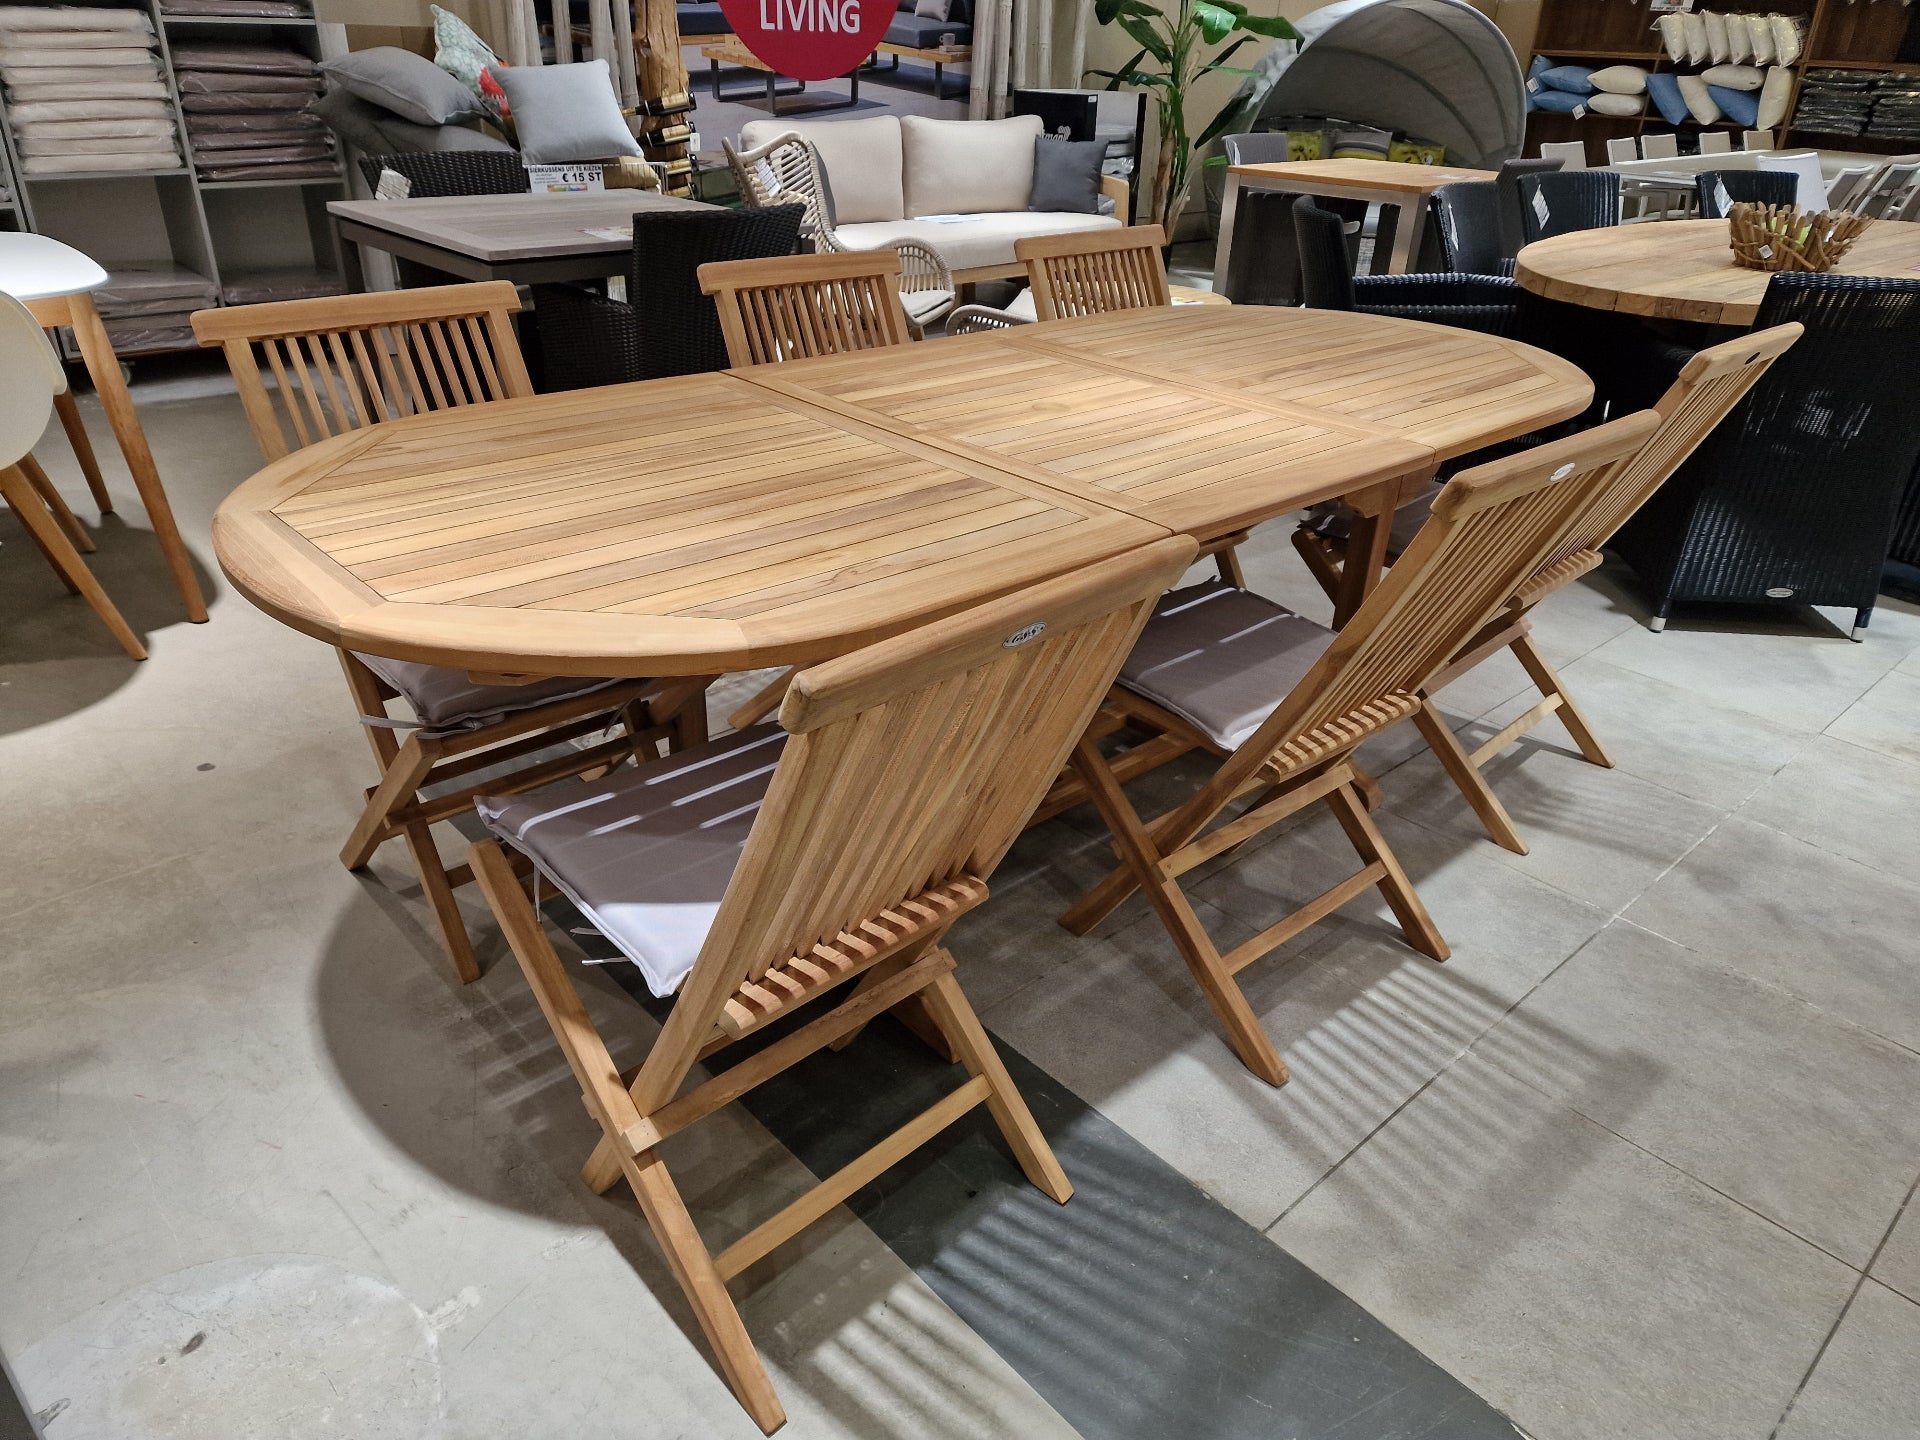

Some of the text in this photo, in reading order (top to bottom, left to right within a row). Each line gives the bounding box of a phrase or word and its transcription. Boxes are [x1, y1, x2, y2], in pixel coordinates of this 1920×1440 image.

[760, 0, 860, 34] LIVING
[562, 173, 569, 182] €
[572, 172, 585, 182] 15
[588, 172, 602, 182] ST
